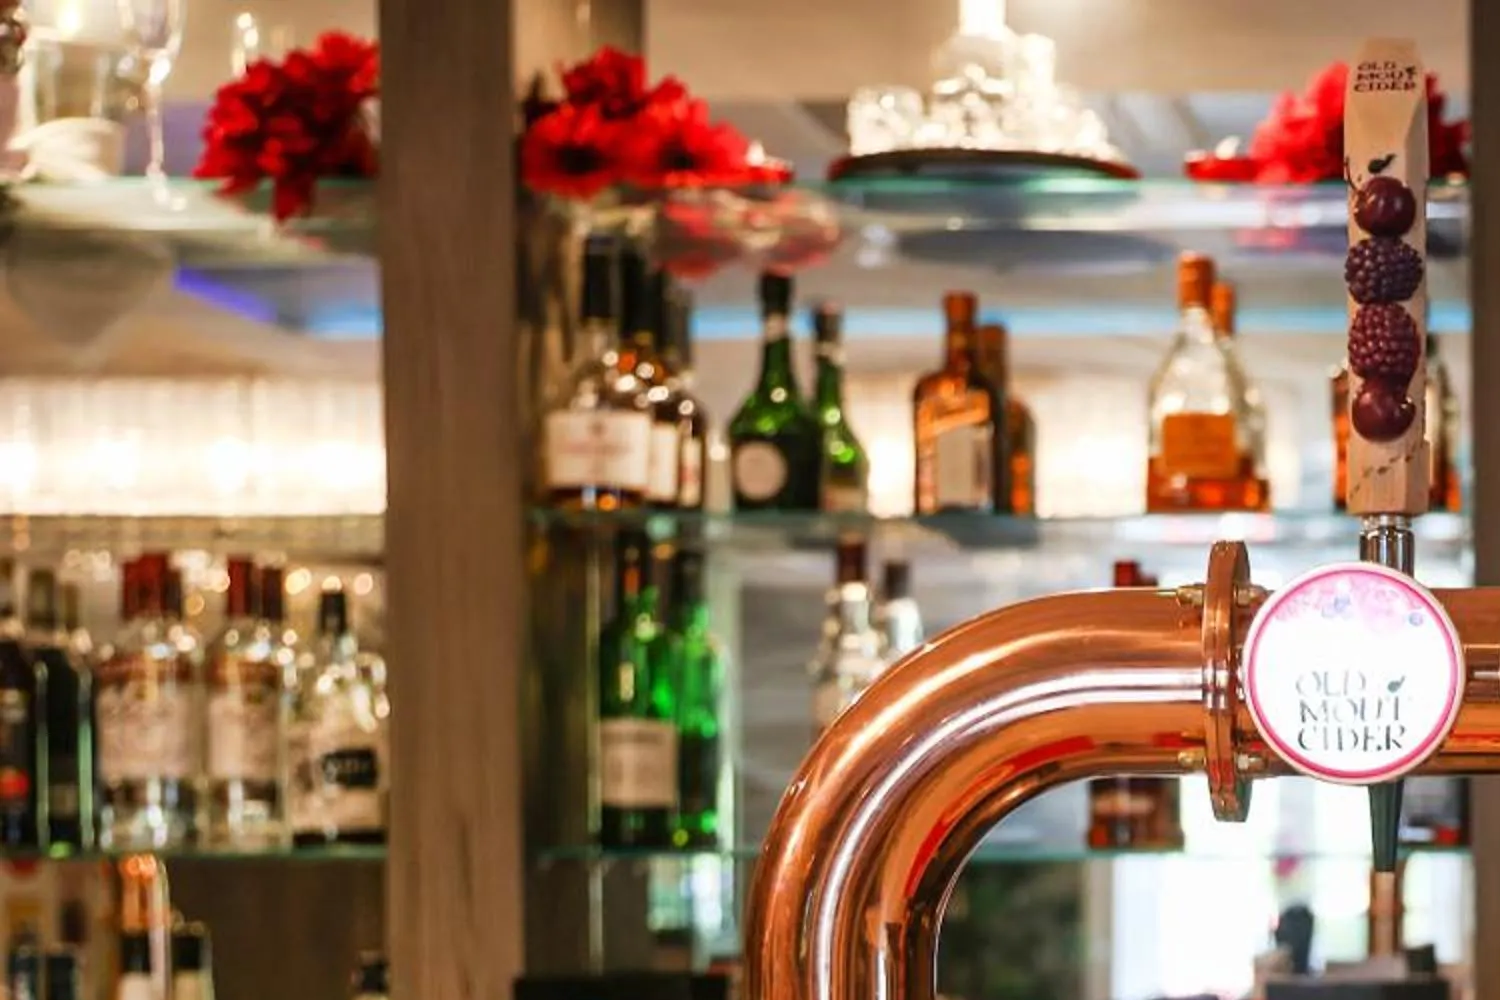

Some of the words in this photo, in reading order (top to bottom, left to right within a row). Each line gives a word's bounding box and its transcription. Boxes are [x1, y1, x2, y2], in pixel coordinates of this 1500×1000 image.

[1357, 61, 1396, 71] OLD
[1353, 82, 1416, 93] CIDER
[1295, 670, 1367, 697] OLD
[1297, 725, 1406, 752] CIDER
